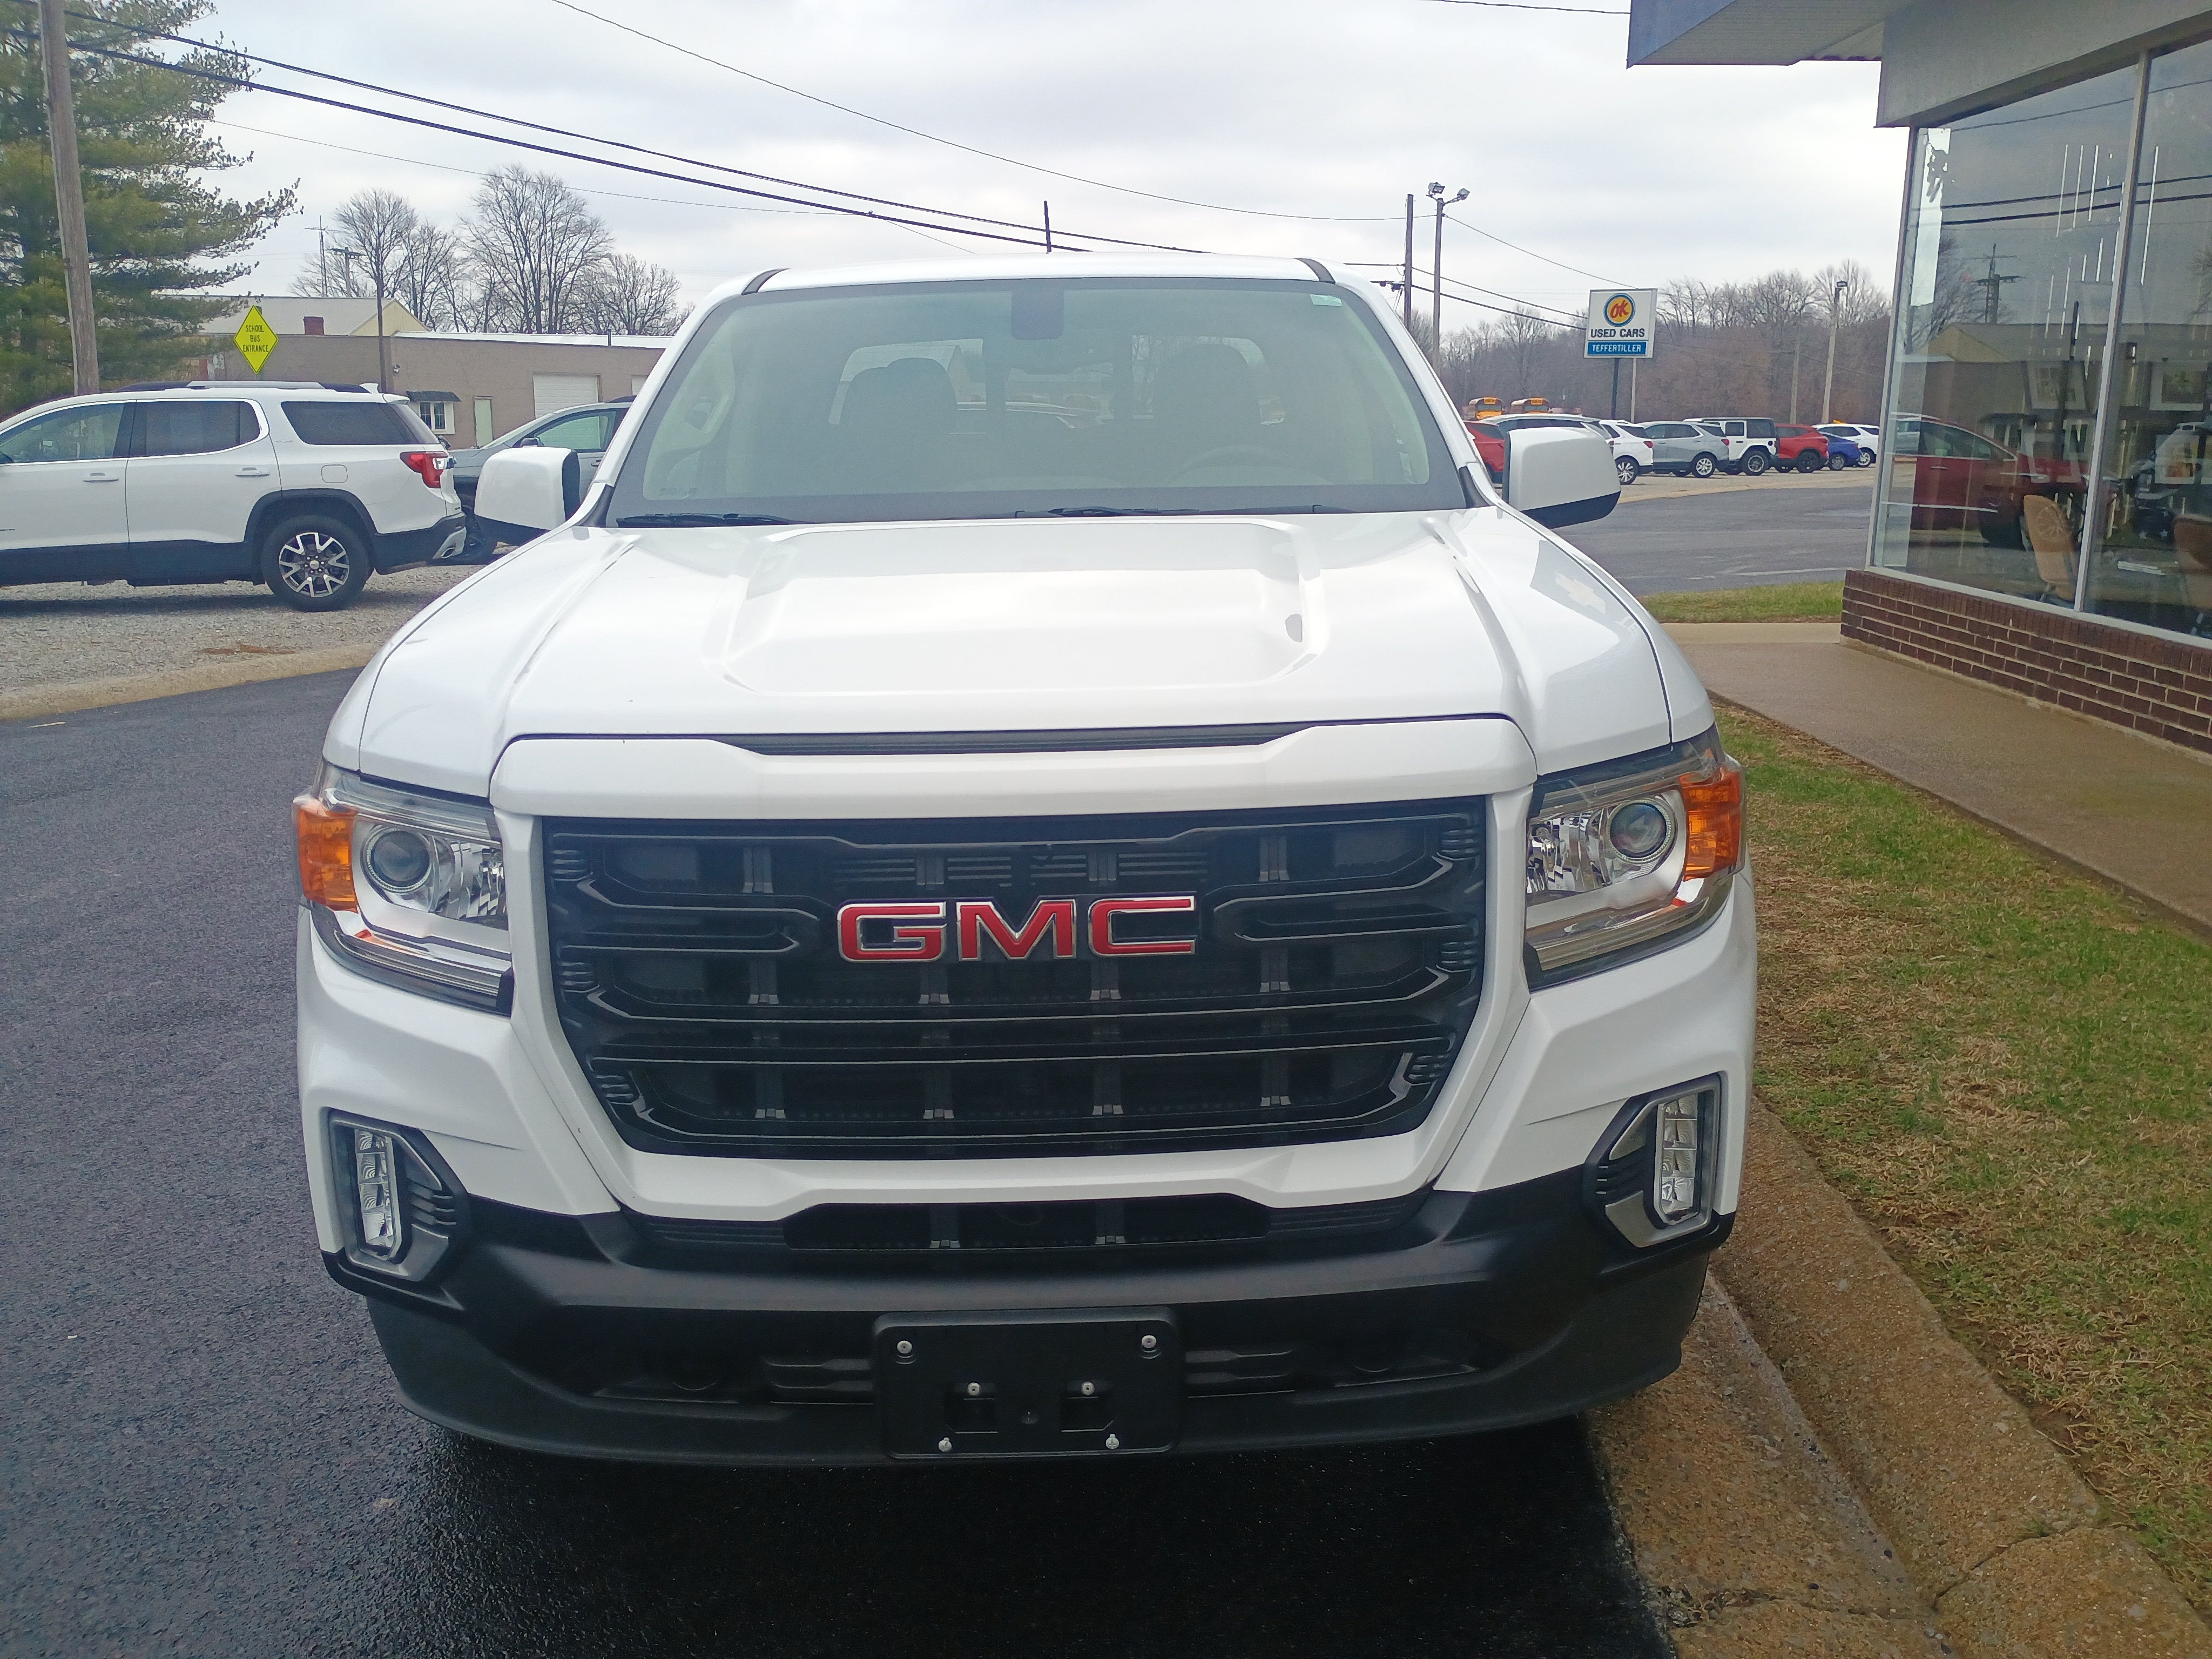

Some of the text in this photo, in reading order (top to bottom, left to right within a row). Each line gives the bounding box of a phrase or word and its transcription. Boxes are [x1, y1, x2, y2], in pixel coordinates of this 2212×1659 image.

[1610, 300, 1629, 318] OK
[1590, 328, 1645, 338] USED CARS
[1592, 344, 1641, 352] TEFFERTILLER
[837, 895, 1196, 962] GMC
